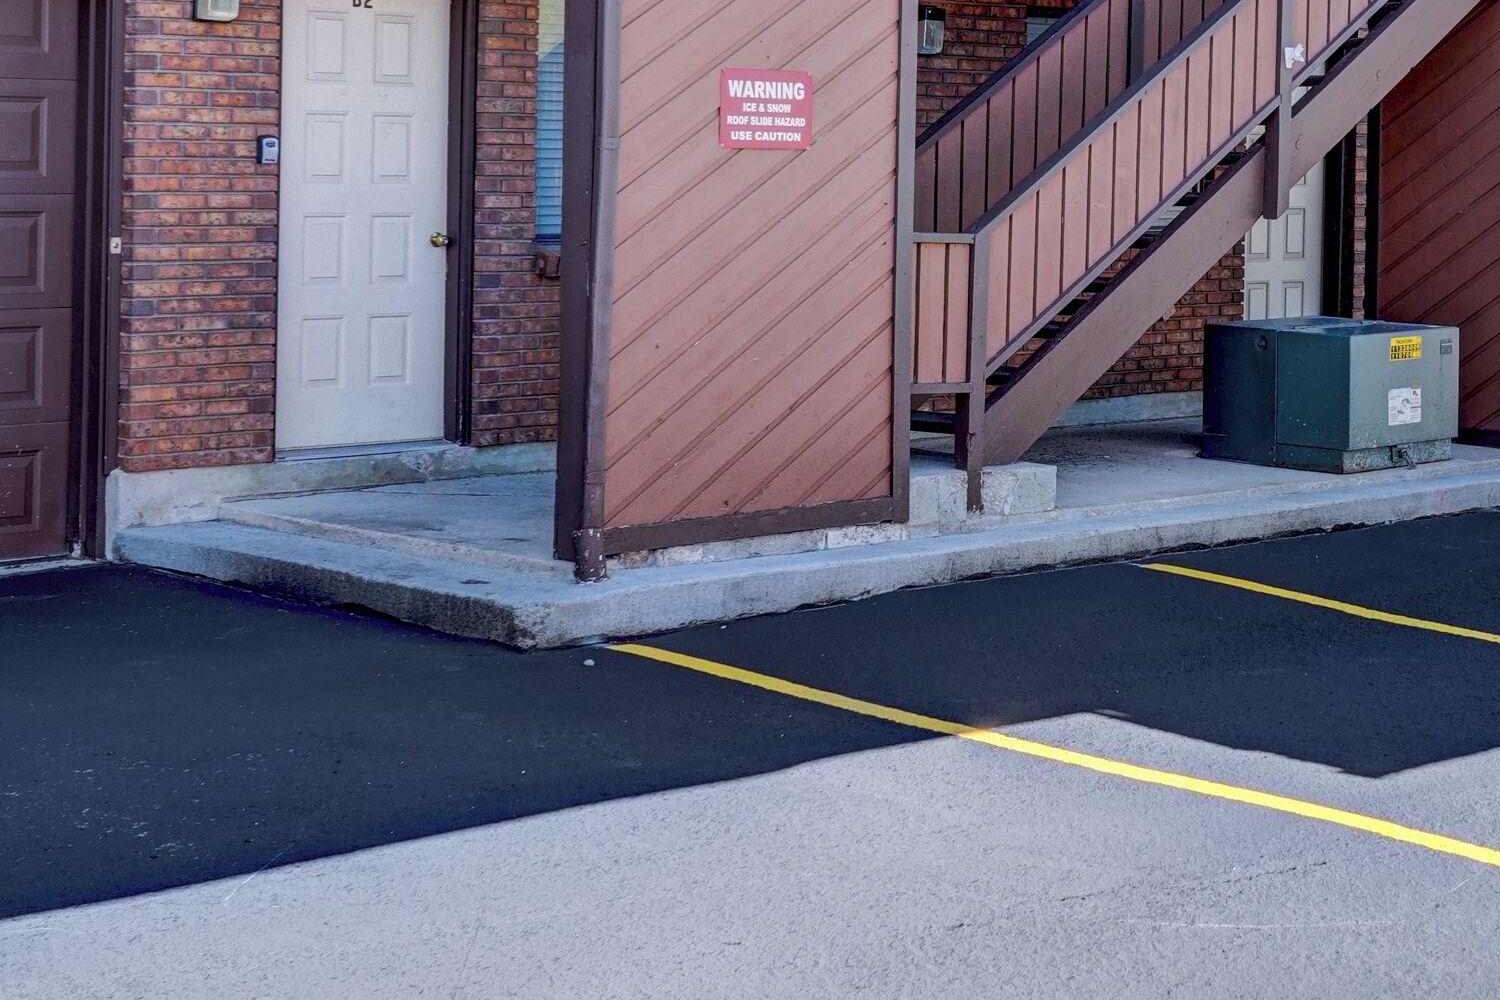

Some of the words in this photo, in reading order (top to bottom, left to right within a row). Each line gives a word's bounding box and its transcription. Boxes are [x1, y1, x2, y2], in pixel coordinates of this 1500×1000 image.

[727, 79, 806, 100] WARNING
[742, 102, 757, 112] ICE
[758, 102, 766, 113] &
[766, 103, 792, 114] SNOW
[726, 115, 749, 125] ROOF
[750, 115, 773, 126] SLIDE
[774, 116, 806, 127] HAZARD
[730, 130, 753, 140] USE
[754, 131, 802, 142] CAUTION
